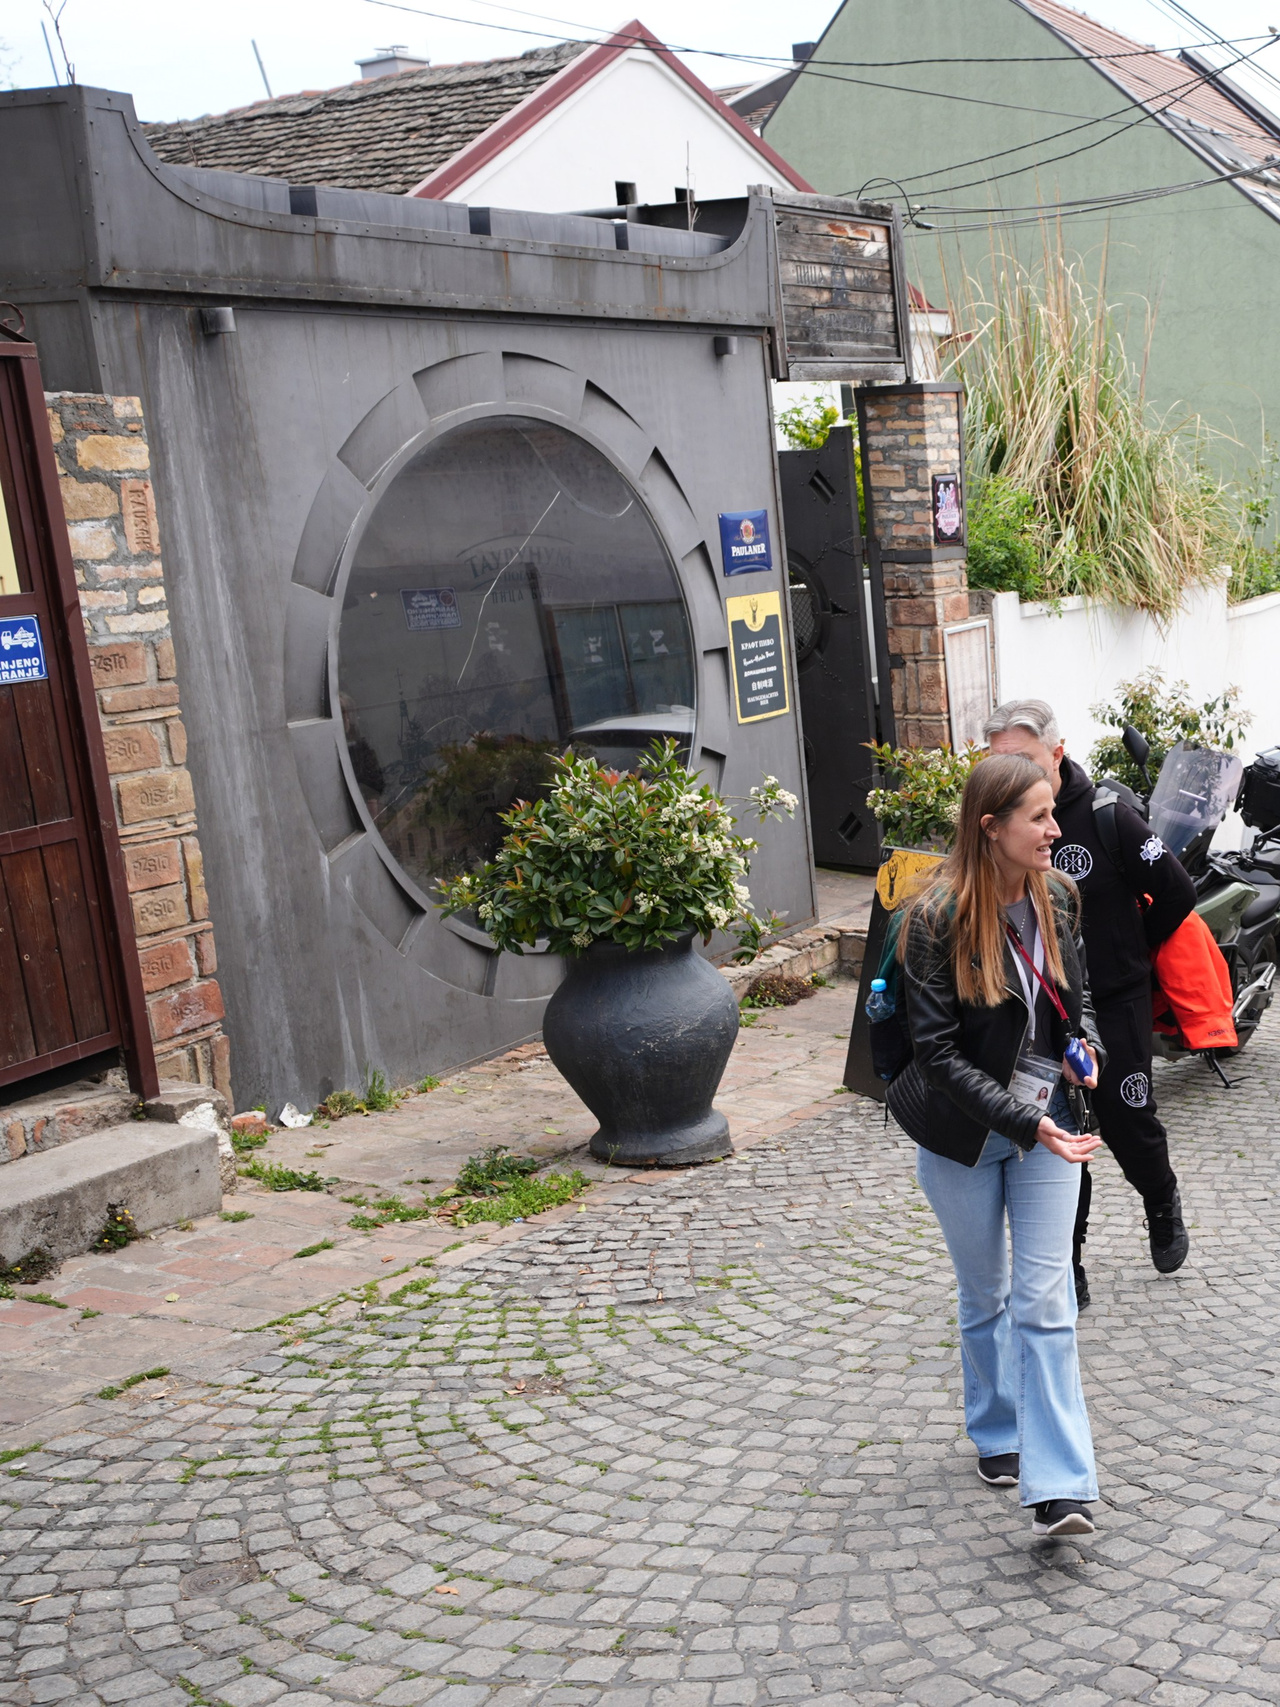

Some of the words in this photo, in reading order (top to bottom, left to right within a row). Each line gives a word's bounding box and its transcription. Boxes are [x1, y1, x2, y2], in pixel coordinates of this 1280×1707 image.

[731, 543, 766, 557] PAULANER
[741, 640, 759, 651] КРАФТ
[759, 638, 775, 648] ПИВО
[0, 657, 40, 671] NJENO
